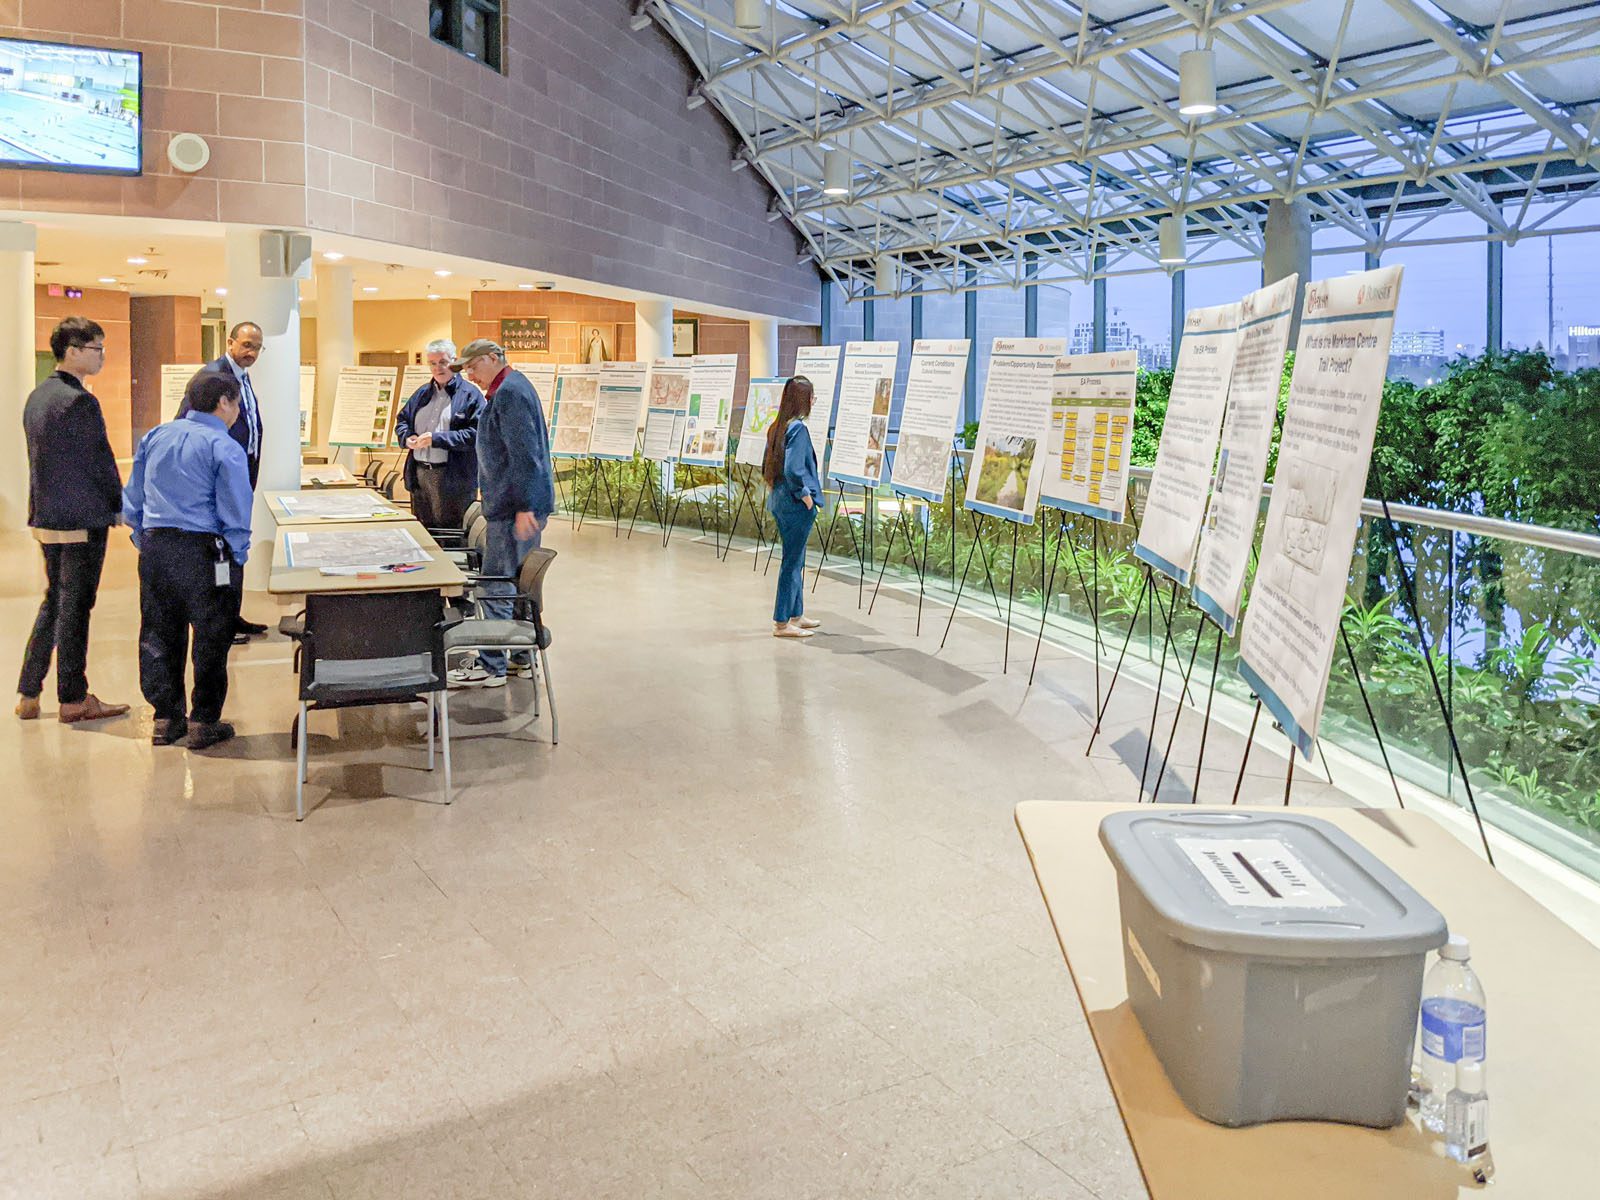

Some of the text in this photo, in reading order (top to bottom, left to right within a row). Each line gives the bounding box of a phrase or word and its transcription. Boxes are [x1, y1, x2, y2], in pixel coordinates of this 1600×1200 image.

[1331, 333, 1355, 349] Markham
[1356, 331, 1378, 348] Centre
[1568, 325, 1600, 337] Hilton
[1329, 357, 1353, 376] Project?
